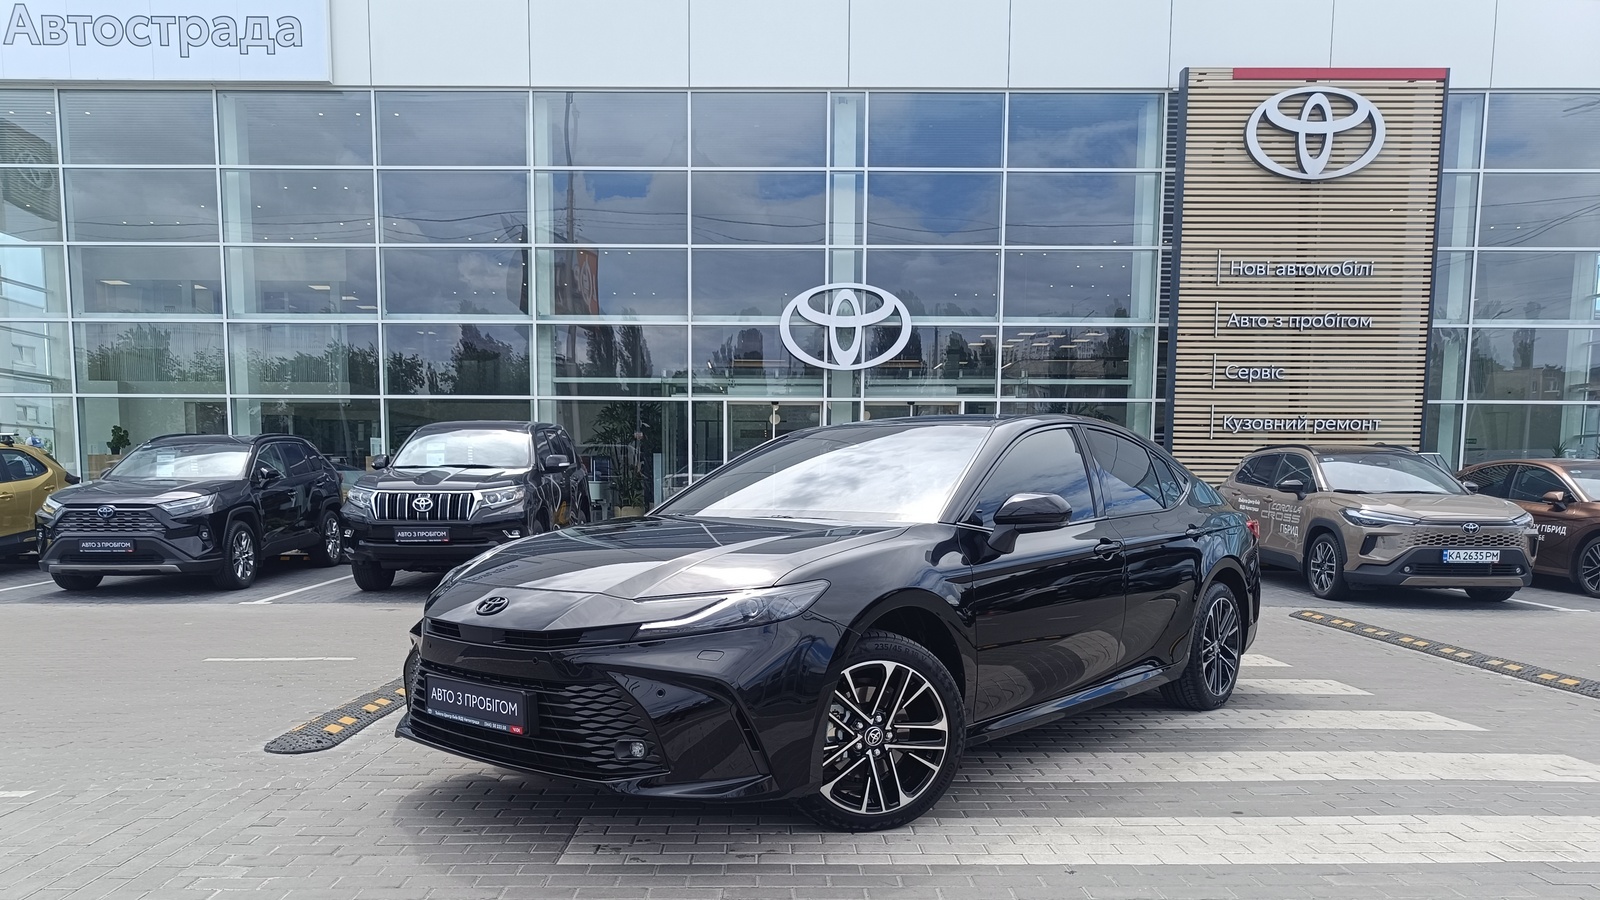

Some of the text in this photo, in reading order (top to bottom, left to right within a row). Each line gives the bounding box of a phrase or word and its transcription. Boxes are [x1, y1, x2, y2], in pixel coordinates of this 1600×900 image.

[3, 3, 303, 58] Автострада
[1230, 260, 1375, 276] Нові автомобілі
[1226, 312, 1373, 332] Авто з пробігом
[1225, 364, 1285, 383] Сервіс
[1222, 415, 1382, 434] Кузовний ремонт
[1271, 503, 1302, 514] COROLLA
[1261, 510, 1300, 523] CROSS
[1280, 523, 1299, 537] ГІБРИД
[1541, 525, 1567, 536] ГІБРИД
[1462, 551, 1484, 561] 2635
[874, 643, 903, 652] 235/45
[431, 687, 455, 703] АВТО
[456, 692, 463, 705] З
[464, 693, 518, 717] ПРОБІГОМ
